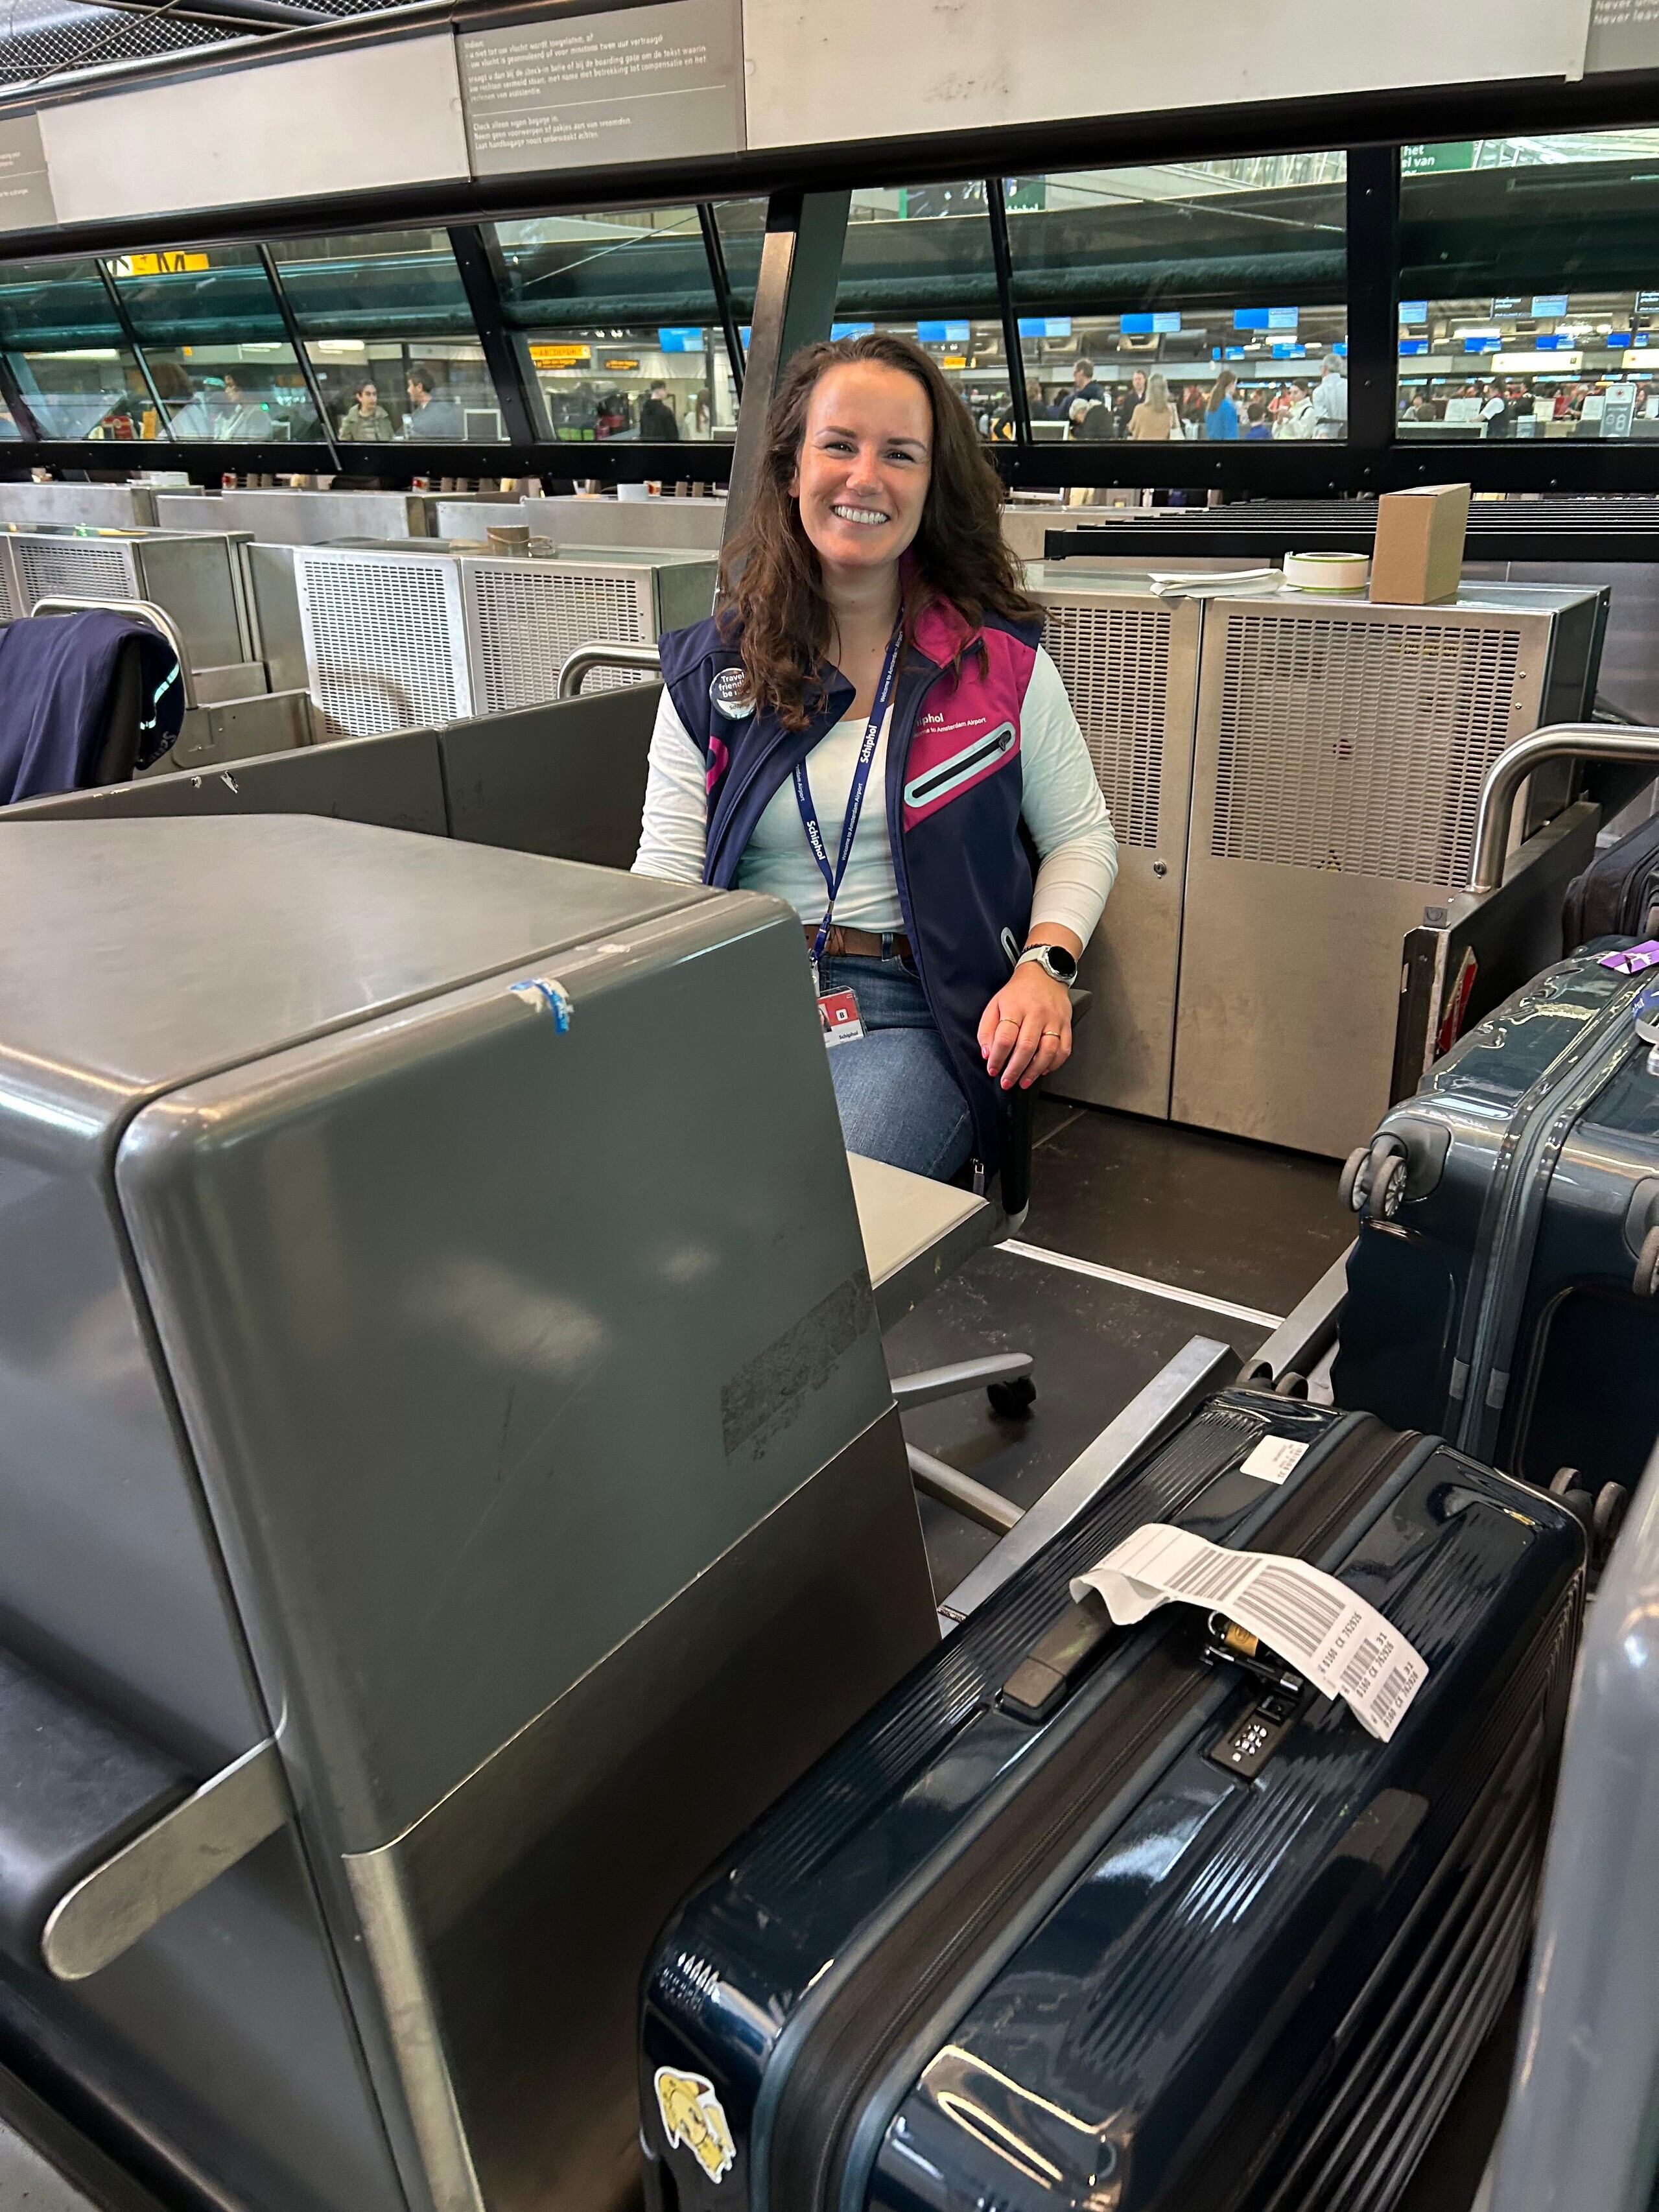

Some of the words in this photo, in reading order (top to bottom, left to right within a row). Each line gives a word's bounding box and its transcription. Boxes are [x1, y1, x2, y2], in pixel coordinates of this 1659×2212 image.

[1594, 13, 1630, 25] Never
[594, 56, 623, 67] boarding
[625, 54, 639, 64] gate
[653, 50, 661, 58] de
[664, 47, 679, 56] tekst
[683, 45, 705, 54] waarin
[594, 65, 628, 78] betrekking
[641, 59, 682, 71] compensatie
[694, 56, 705, 65] het
[1404, 145, 1425, 156] het
[1414, 156, 1435, 167] van
[721, 672, 745, 683] Travel
[718, 679, 744, 692] friend
[879, 681, 891, 702] Welcome
[937, 721, 967, 733] Amsterdam
[967, 716, 987, 725] Airport
[860, 725, 878, 764] Schiphol
[841, 838, 851, 861] Welcome
[848, 802, 859, 832] Amsterdam
[854, 782, 864, 802] Airport
[806, 820, 827, 860] Schiphol
[838, 1030, 859, 1040] Schiphol
[1376, 1632, 1387, 1645] 31
